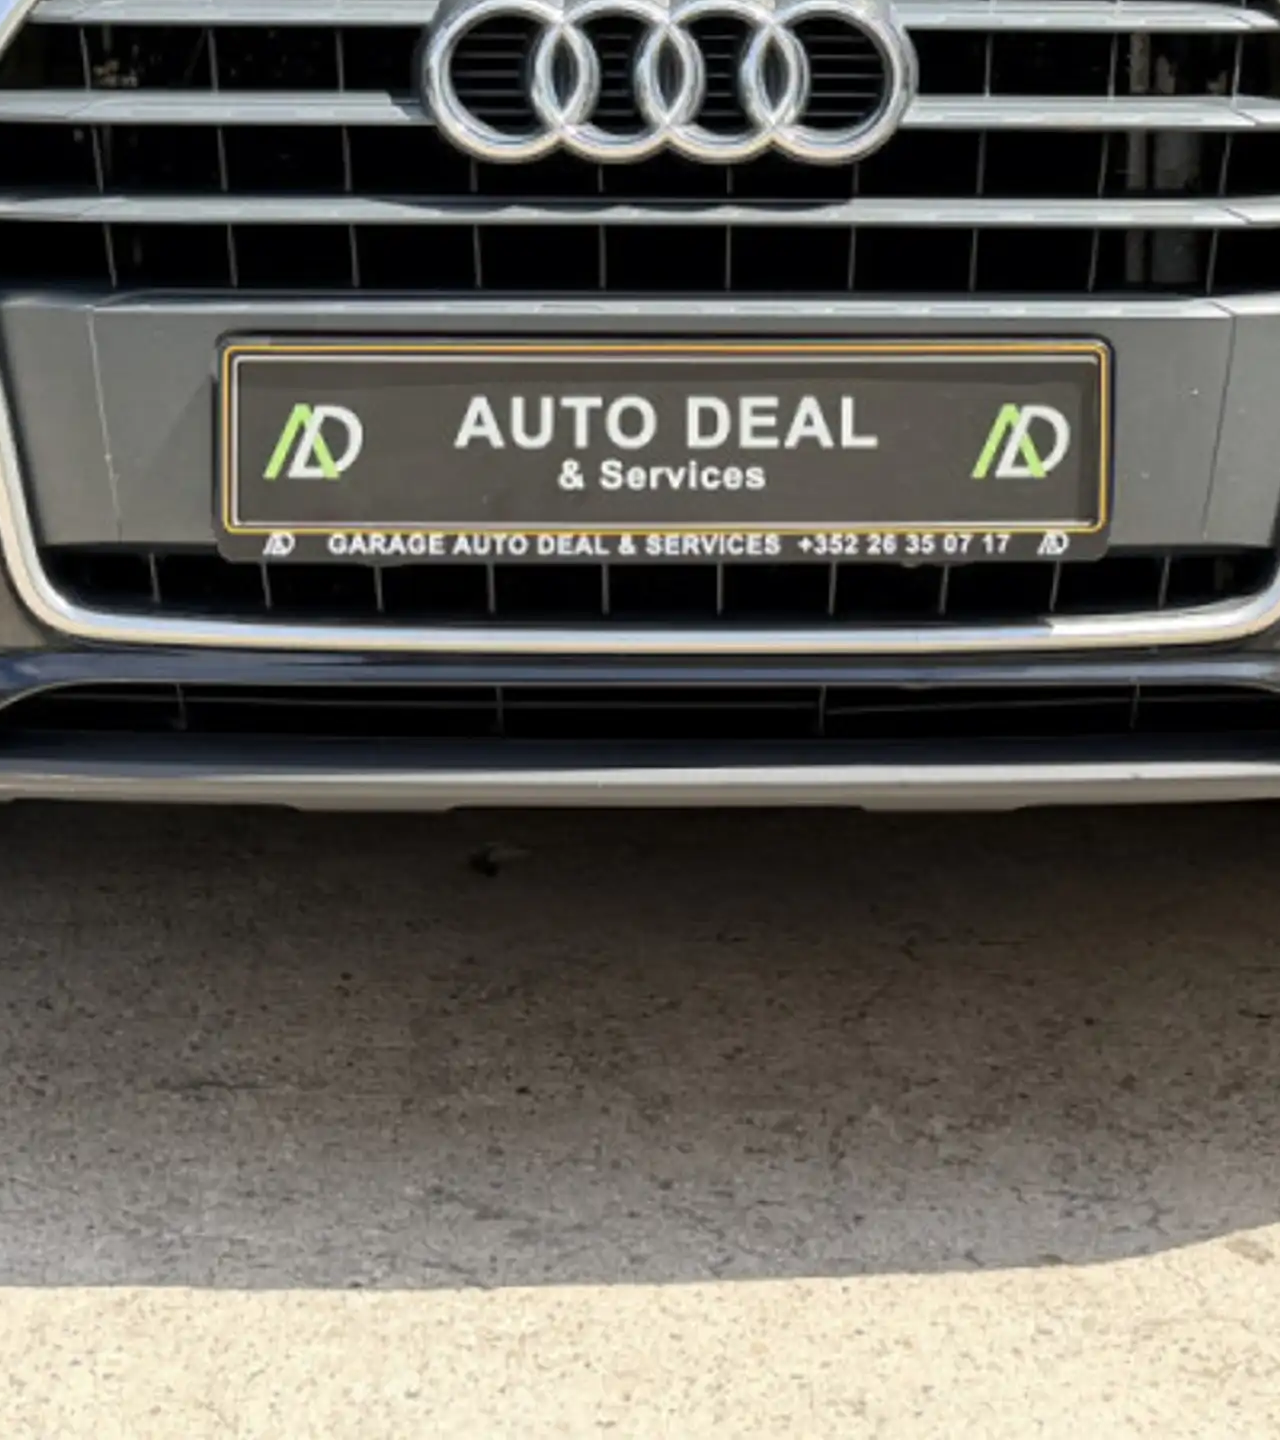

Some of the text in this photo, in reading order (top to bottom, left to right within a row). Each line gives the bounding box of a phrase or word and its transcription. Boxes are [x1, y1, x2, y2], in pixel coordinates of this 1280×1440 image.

[454, 396, 878, 449] AUTO DEAL
[557, 458, 766, 490] & Services
[327, 533, 446, 556] GARAGE
[452, 533, 528, 556] AUTO
[536, 533, 609, 556] DEAL
[617, 533, 635, 556] &
[646, 533, 781, 556] SERVICES
[797, 533, 859, 555] +352
[867, 533, 897, 555] 26
[905, 533, 935, 555] 35
[942, 533, 972, 555] 07
[981, 533, 1011, 555] 17
